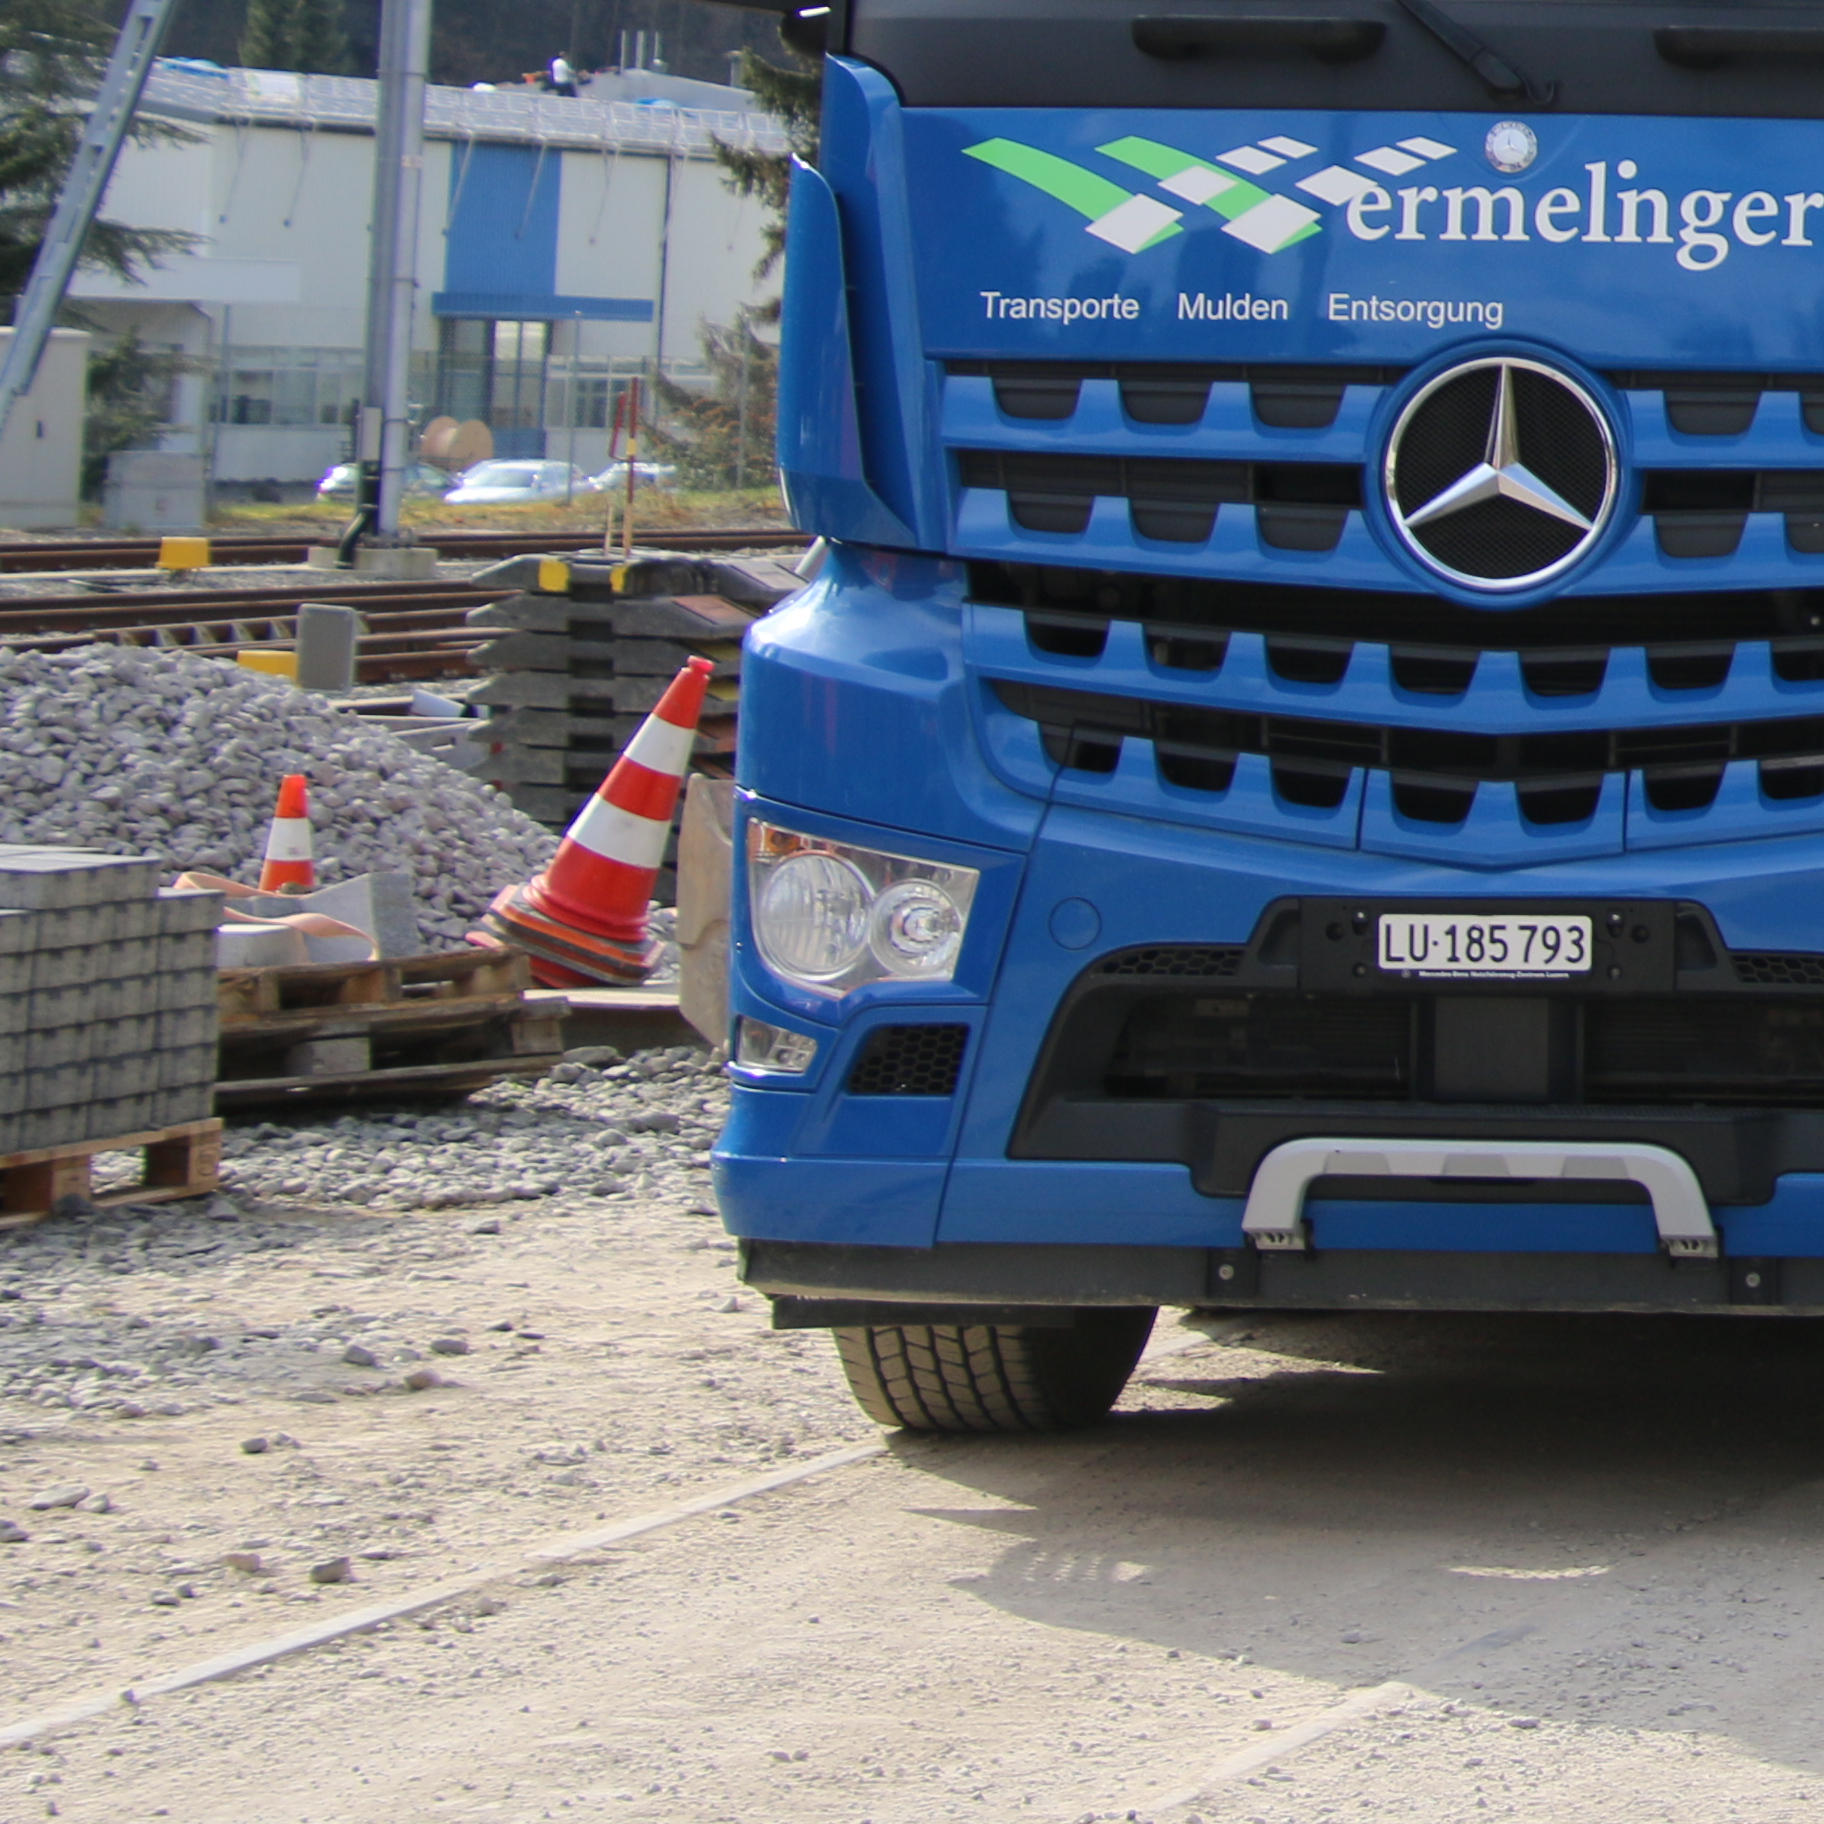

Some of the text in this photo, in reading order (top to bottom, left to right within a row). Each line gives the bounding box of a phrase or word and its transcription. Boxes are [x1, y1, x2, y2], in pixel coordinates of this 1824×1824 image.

[980, 292, 1504, 328] Transporte Mulden Entsorgung
